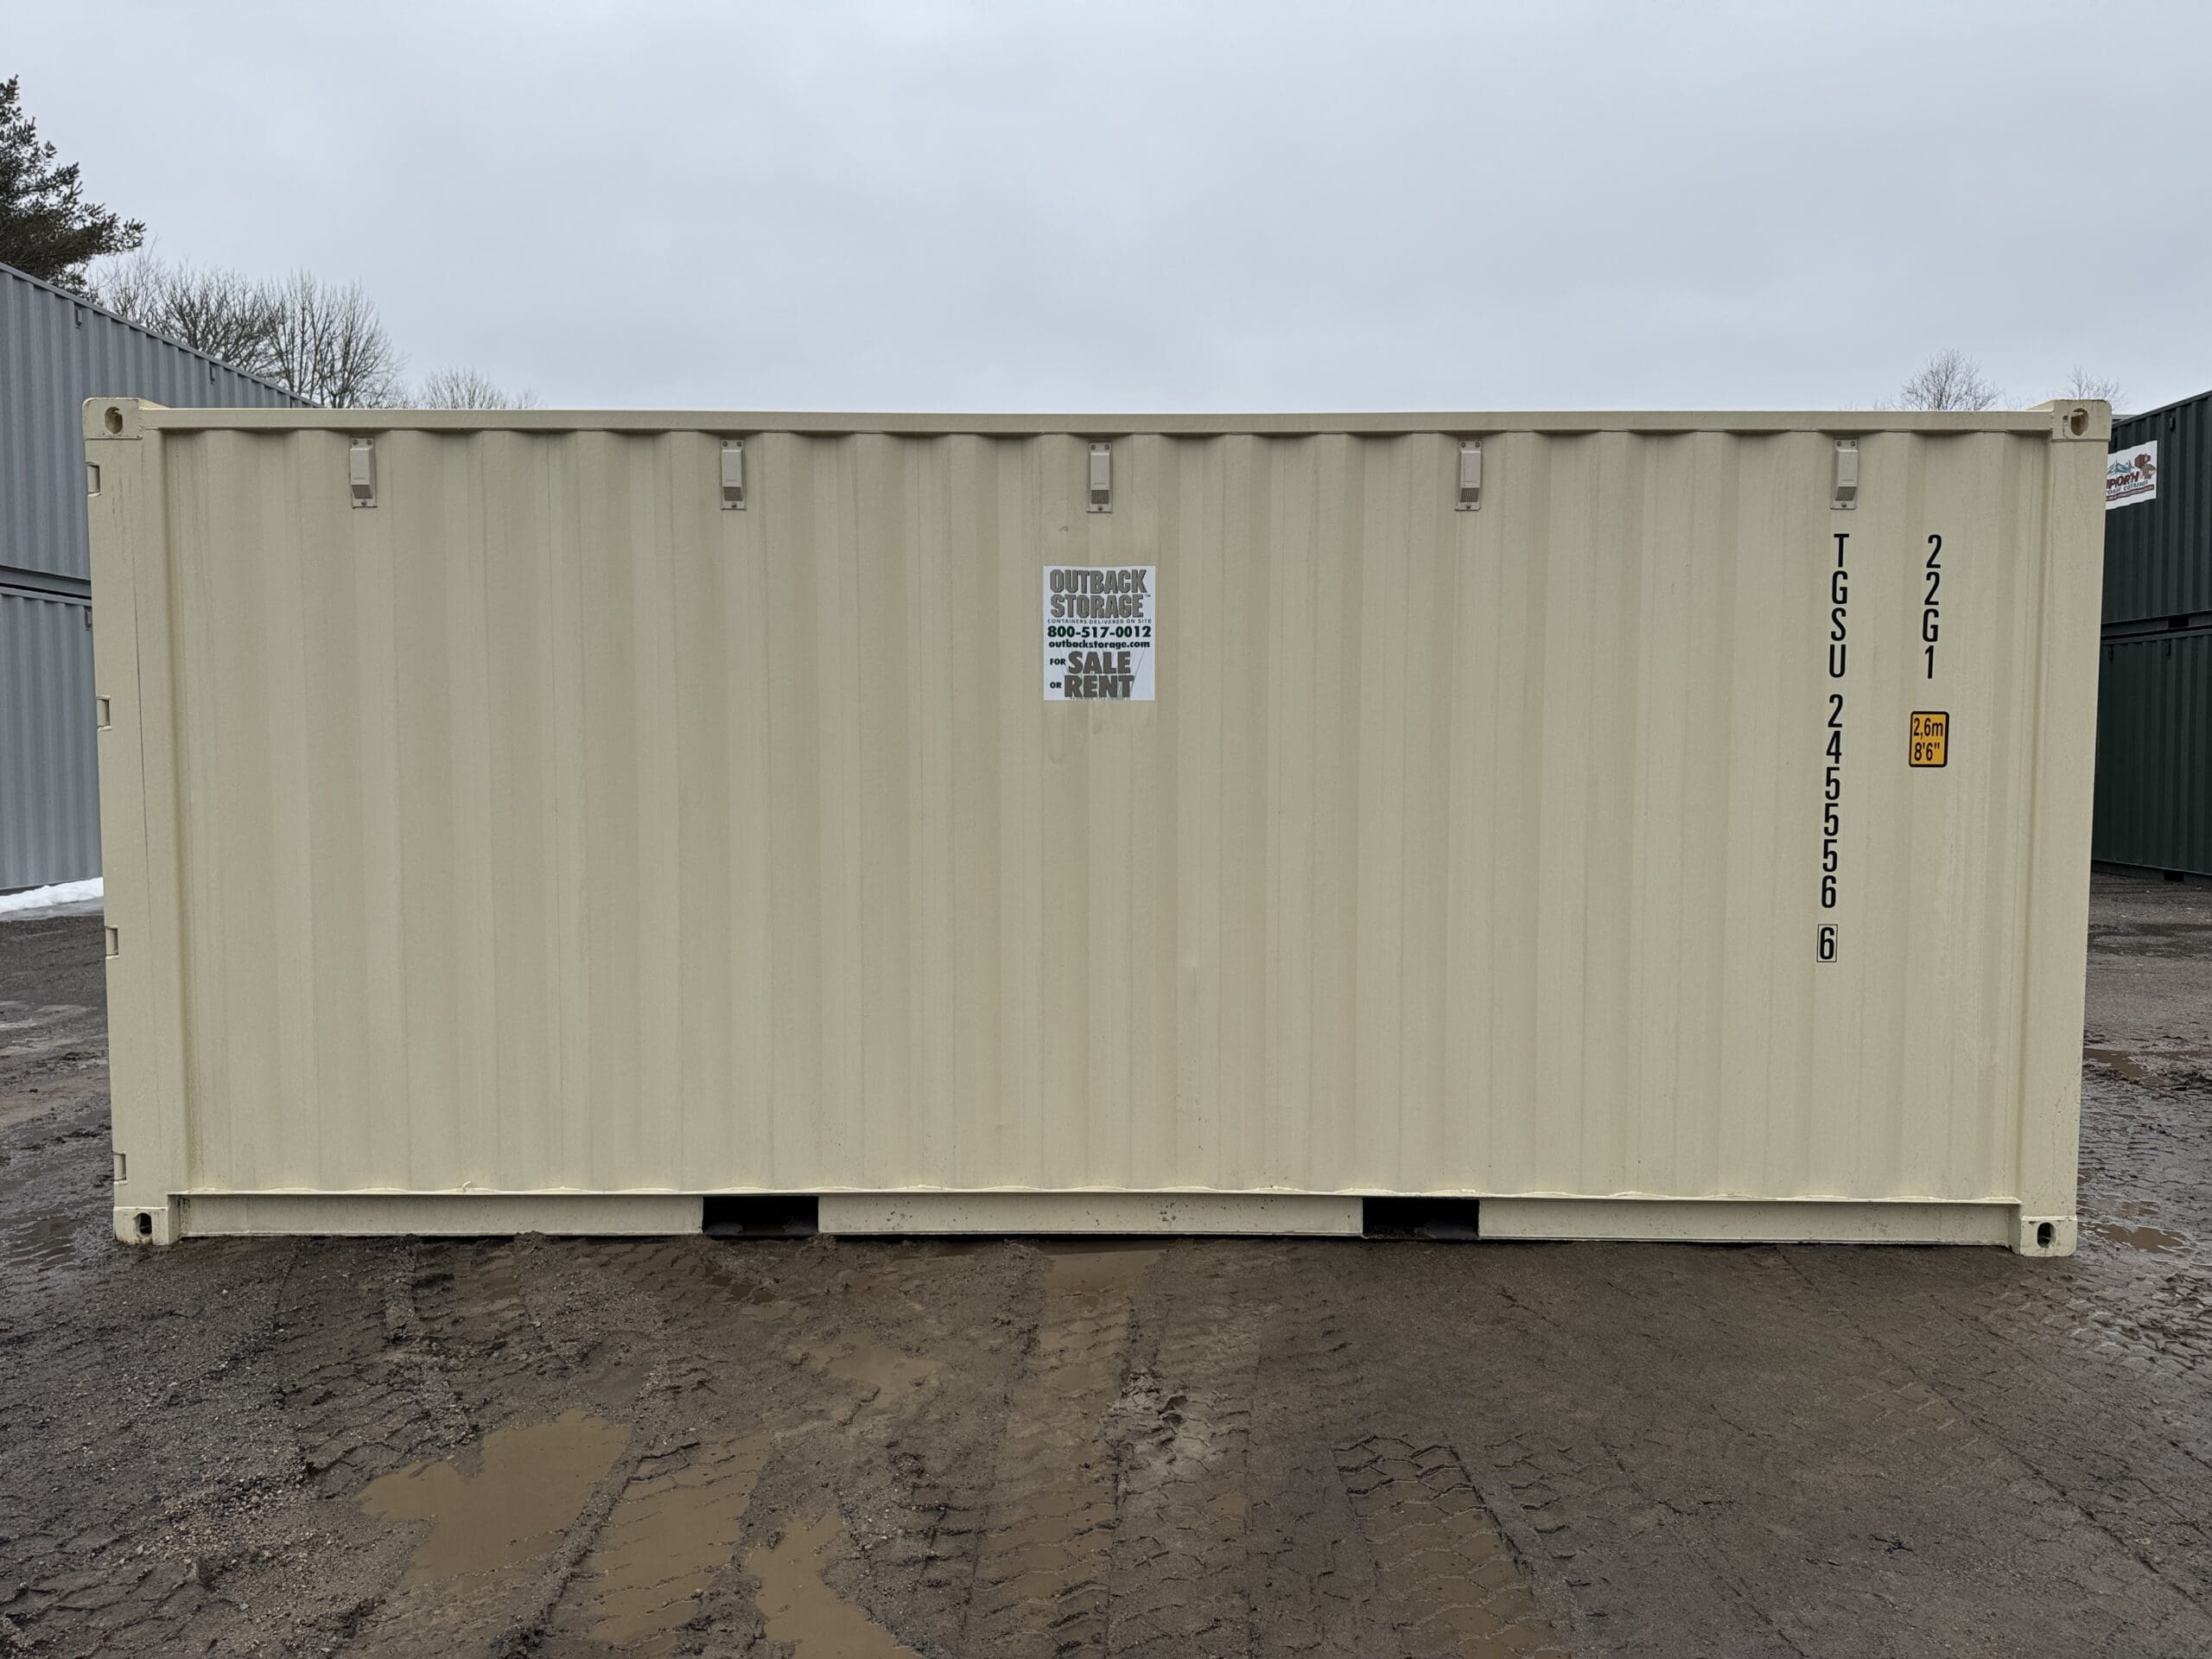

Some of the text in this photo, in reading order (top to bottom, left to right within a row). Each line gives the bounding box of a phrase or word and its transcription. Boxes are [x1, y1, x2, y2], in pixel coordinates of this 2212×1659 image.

[1049, 569, 1148, 594] OUTBACK
[1050, 594, 1144, 619] STORAGE
[1923, 534, 1942, 679] 22G1
[1047, 626, 1152, 638] 800-517-0012
[1048, 639, 1151, 650] outbackstorage.com
[1068, 651, 1131, 674] SALE
[1065, 675, 1135, 698] RENT
[1819, 533, 1850, 960] TGSU 245556 6
[1914, 742, 1941, 761] 8'6"
